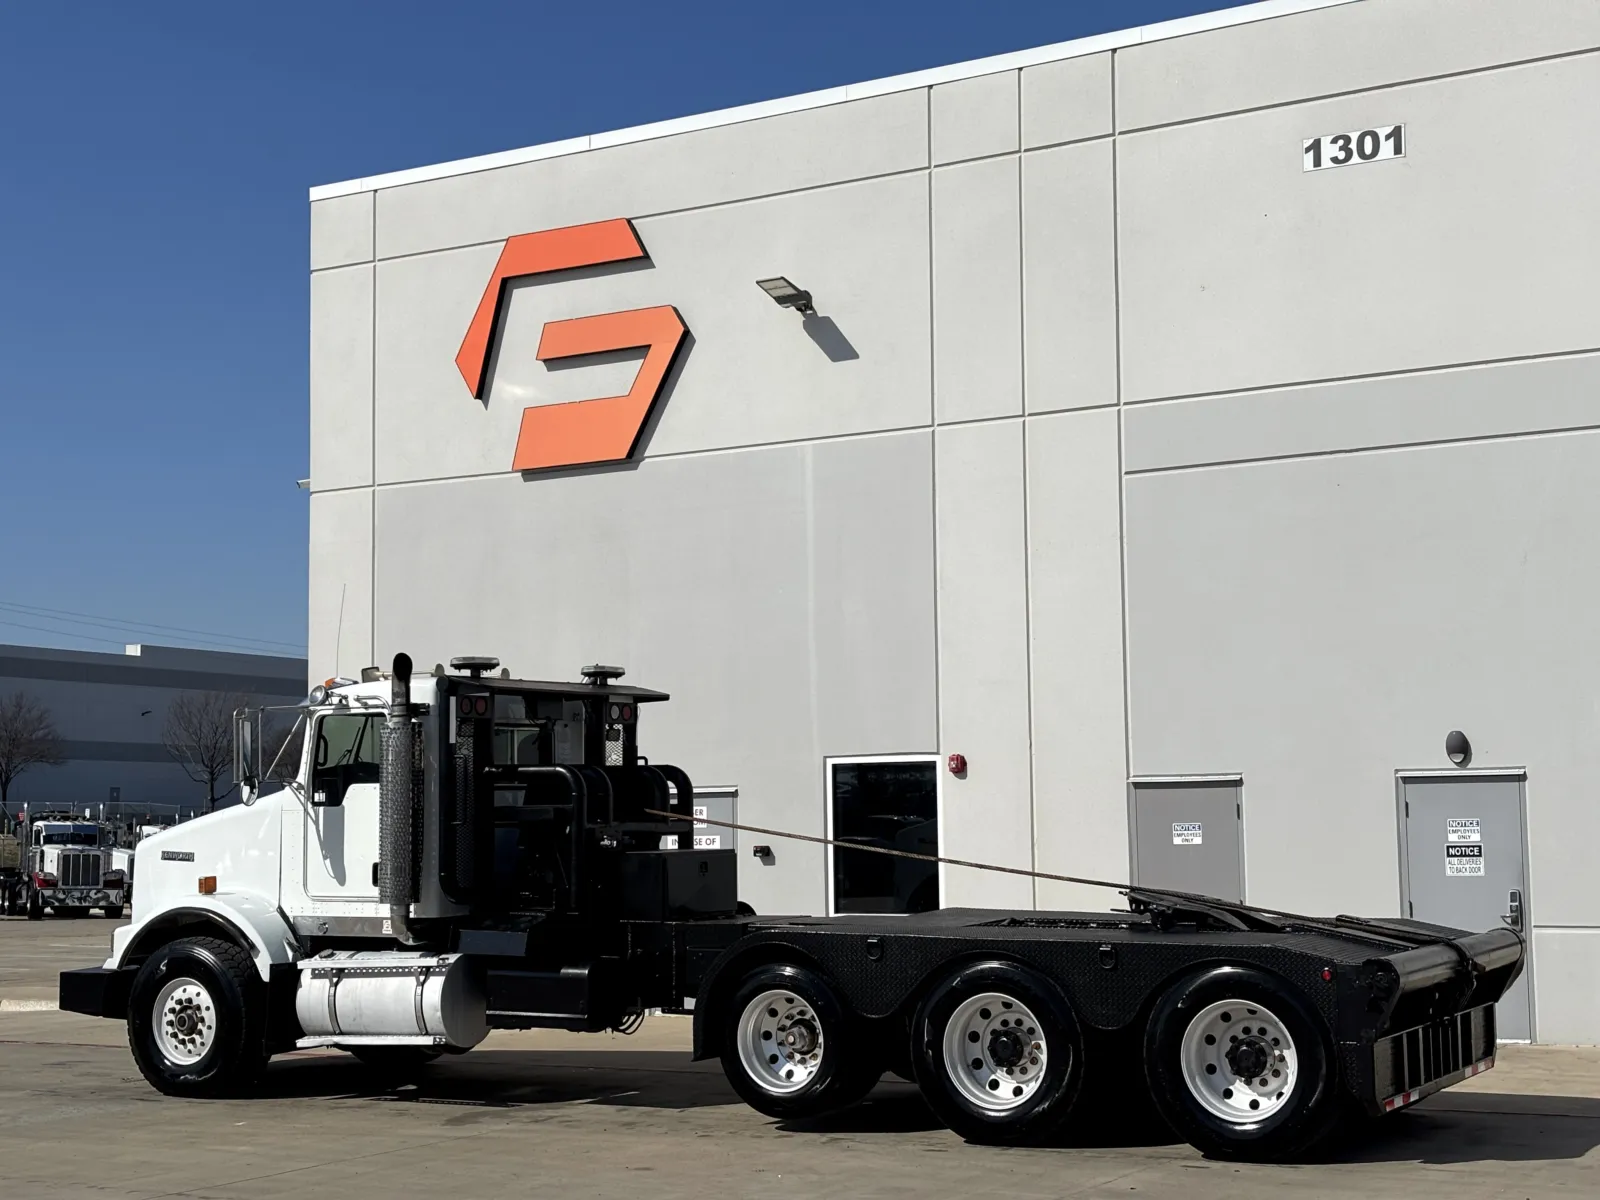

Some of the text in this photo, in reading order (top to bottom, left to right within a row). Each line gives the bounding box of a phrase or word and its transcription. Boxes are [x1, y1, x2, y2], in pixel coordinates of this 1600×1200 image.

[1305, 125, 1402, 168] 1301
[1449, 820, 1480, 828] NOTICE
[705, 838, 717, 846] OF
[1448, 847, 1480, 856] NOTICE
